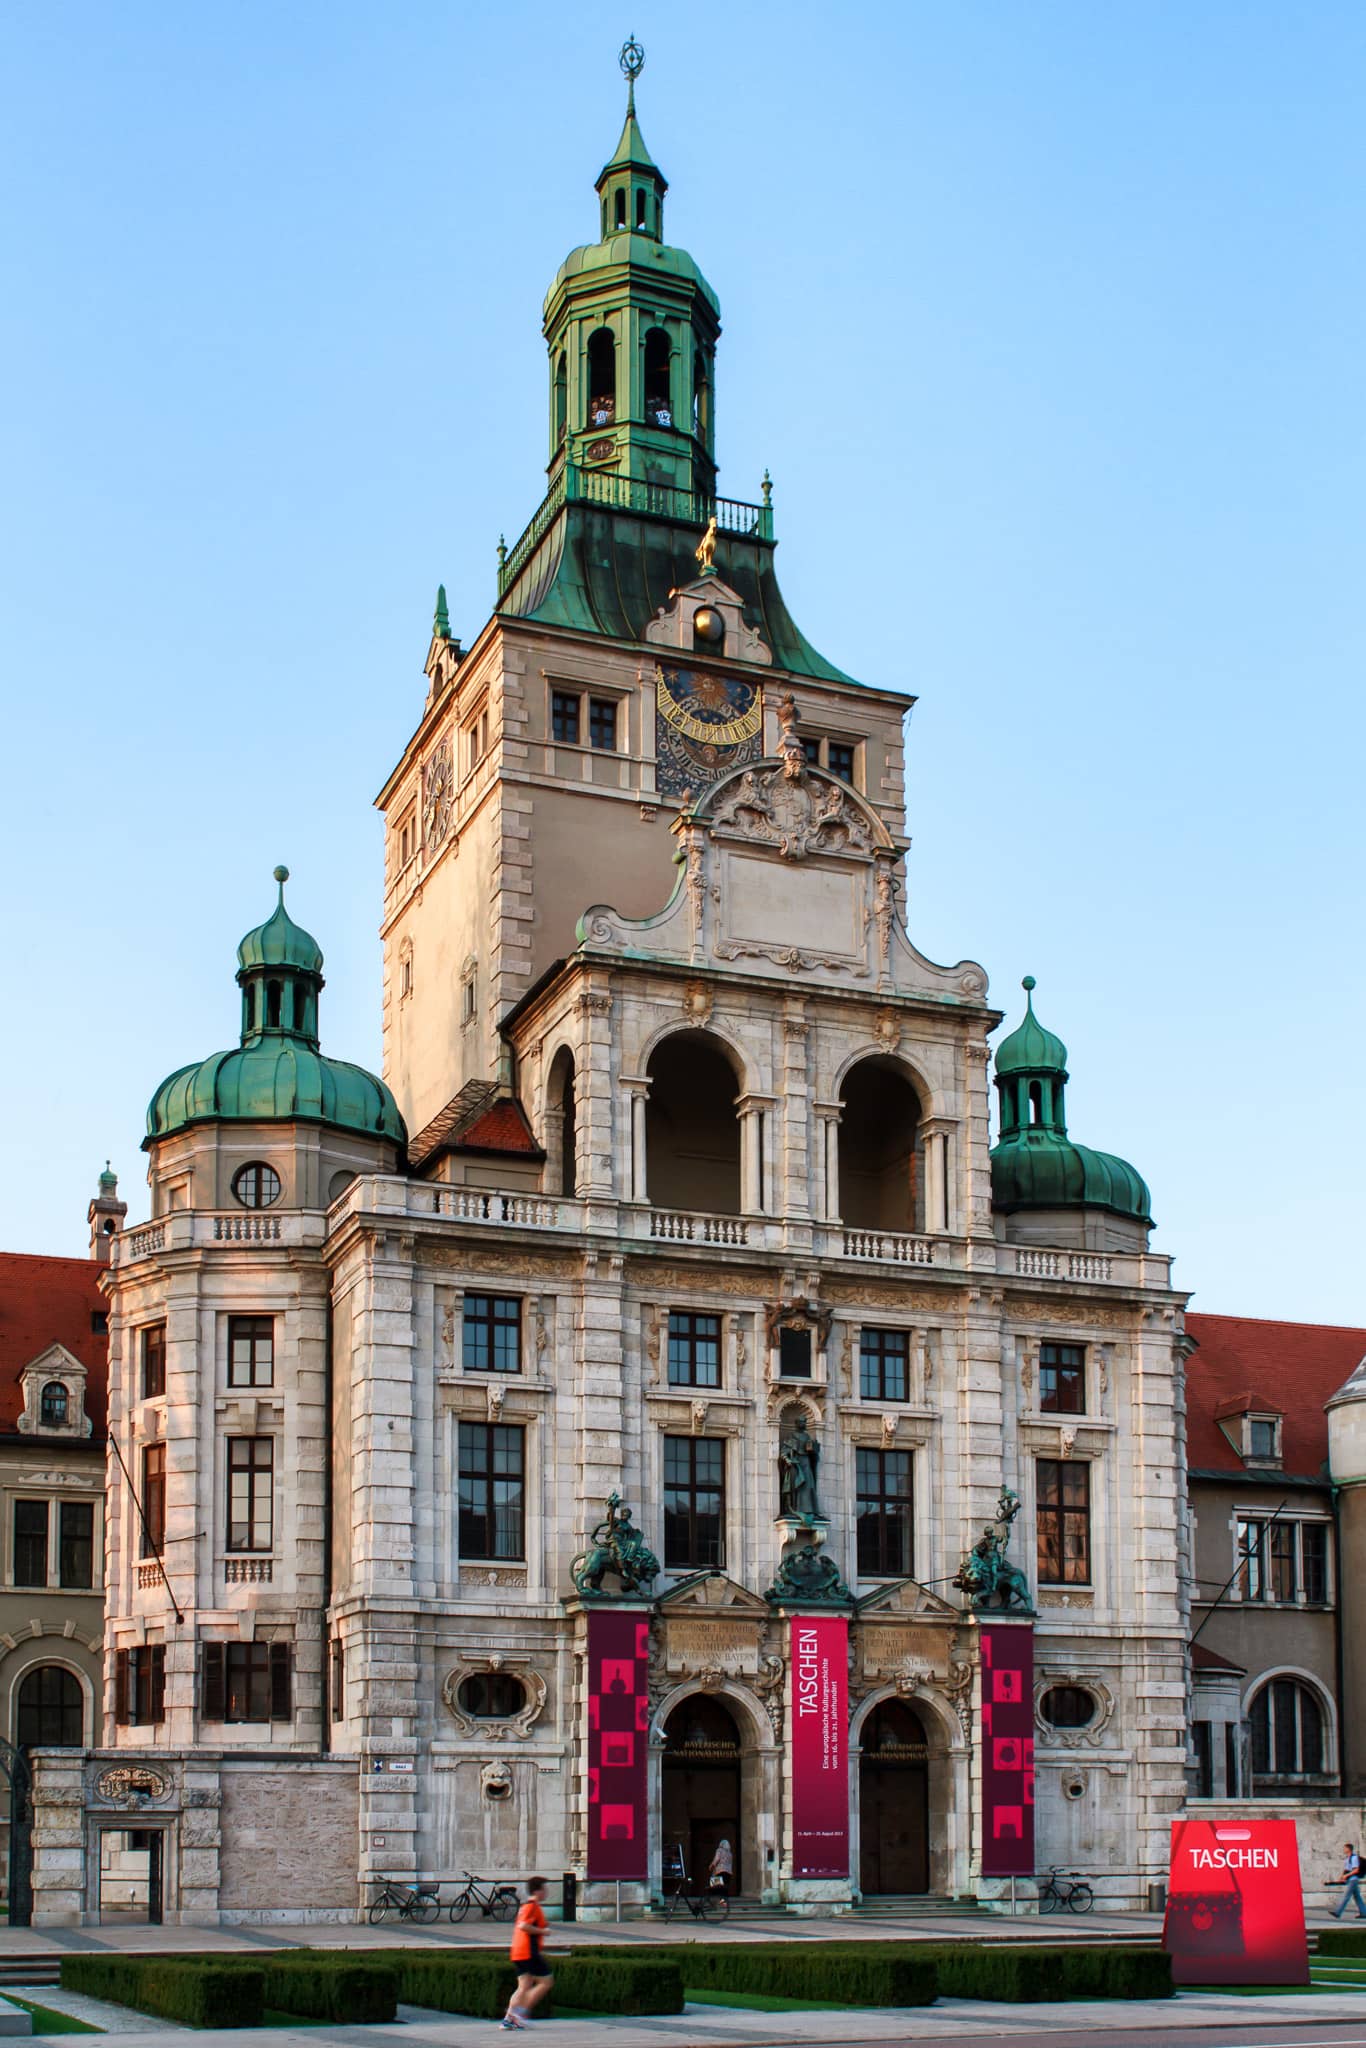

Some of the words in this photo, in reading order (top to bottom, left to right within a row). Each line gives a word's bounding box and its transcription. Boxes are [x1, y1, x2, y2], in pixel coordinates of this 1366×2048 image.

[799, 1629, 818, 1718] TASCHEN
[822, 1658, 830, 1712] Kulturgeschichte
[822, 1713, 830, 1754] europäische
[1189, 1848, 1279, 1869] TASCHEN
